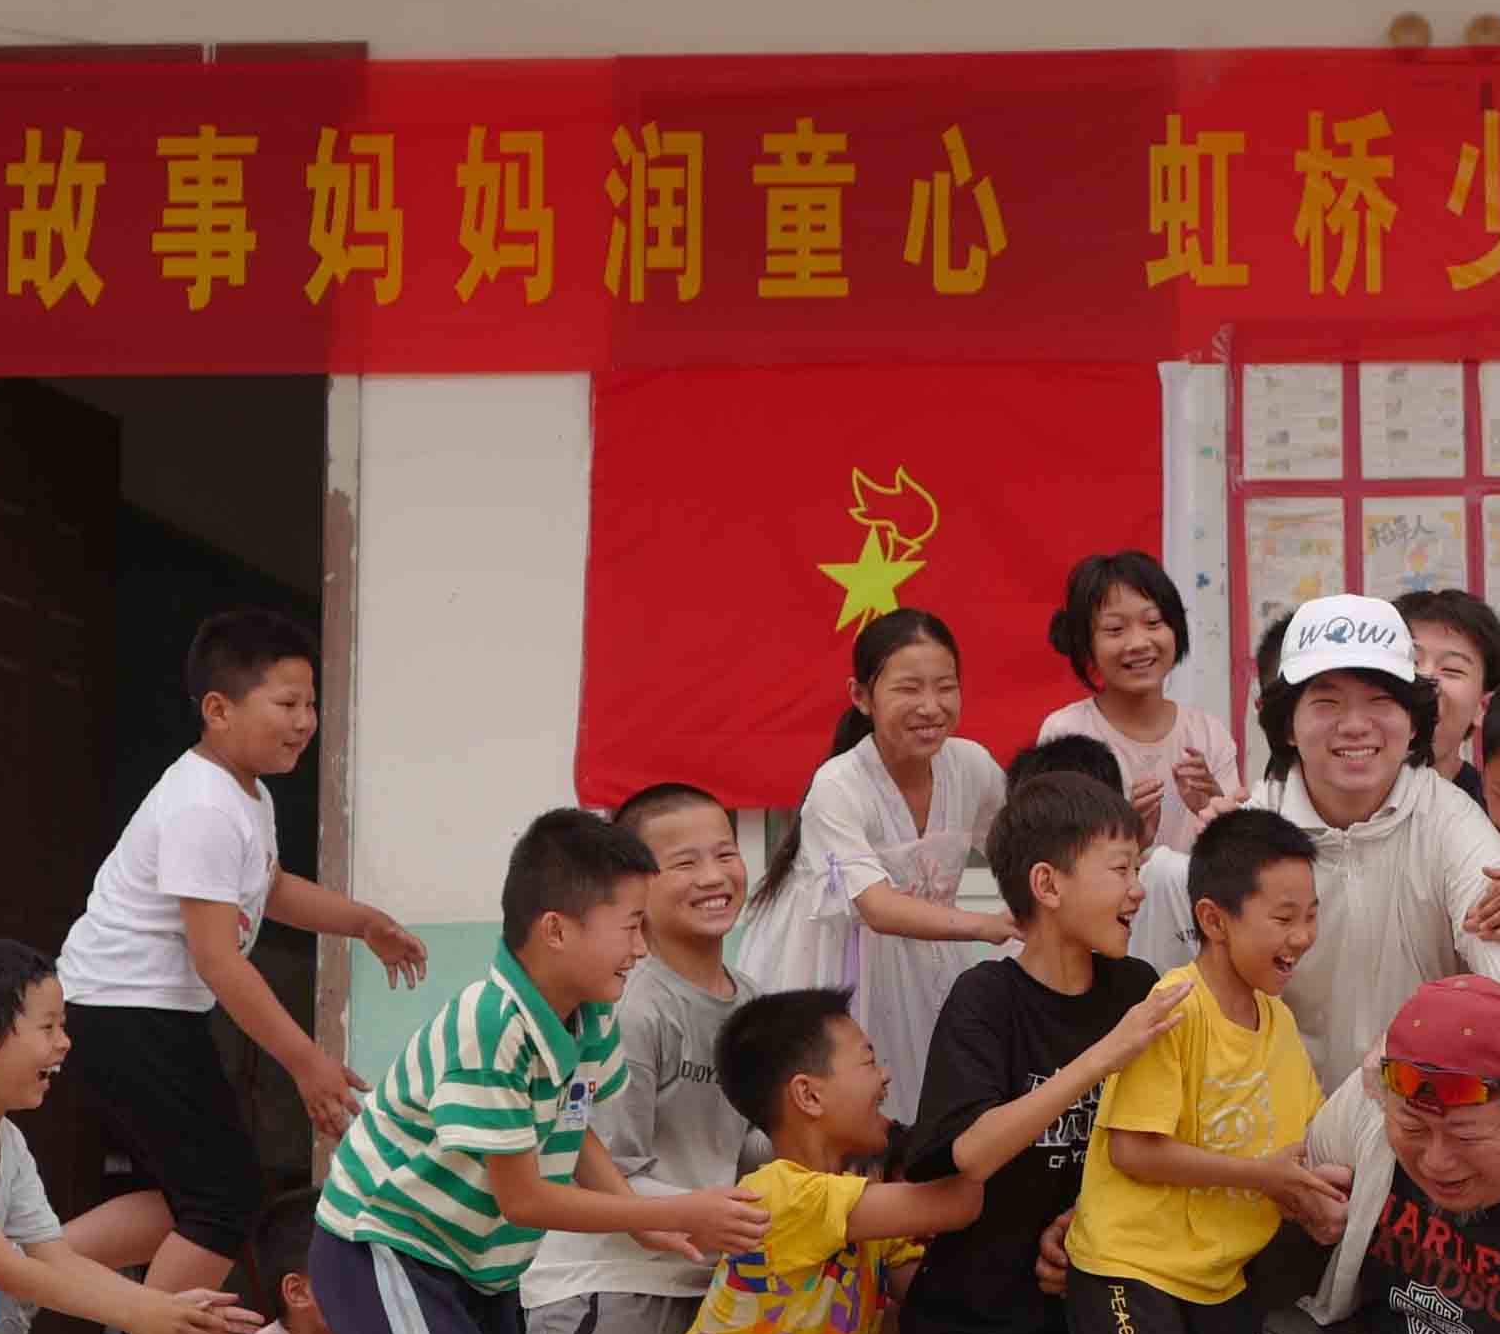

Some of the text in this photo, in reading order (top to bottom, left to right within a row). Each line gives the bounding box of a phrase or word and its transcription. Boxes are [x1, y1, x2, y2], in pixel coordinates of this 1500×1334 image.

[4, 117, 1008, 312] 故事妈妈润童心
